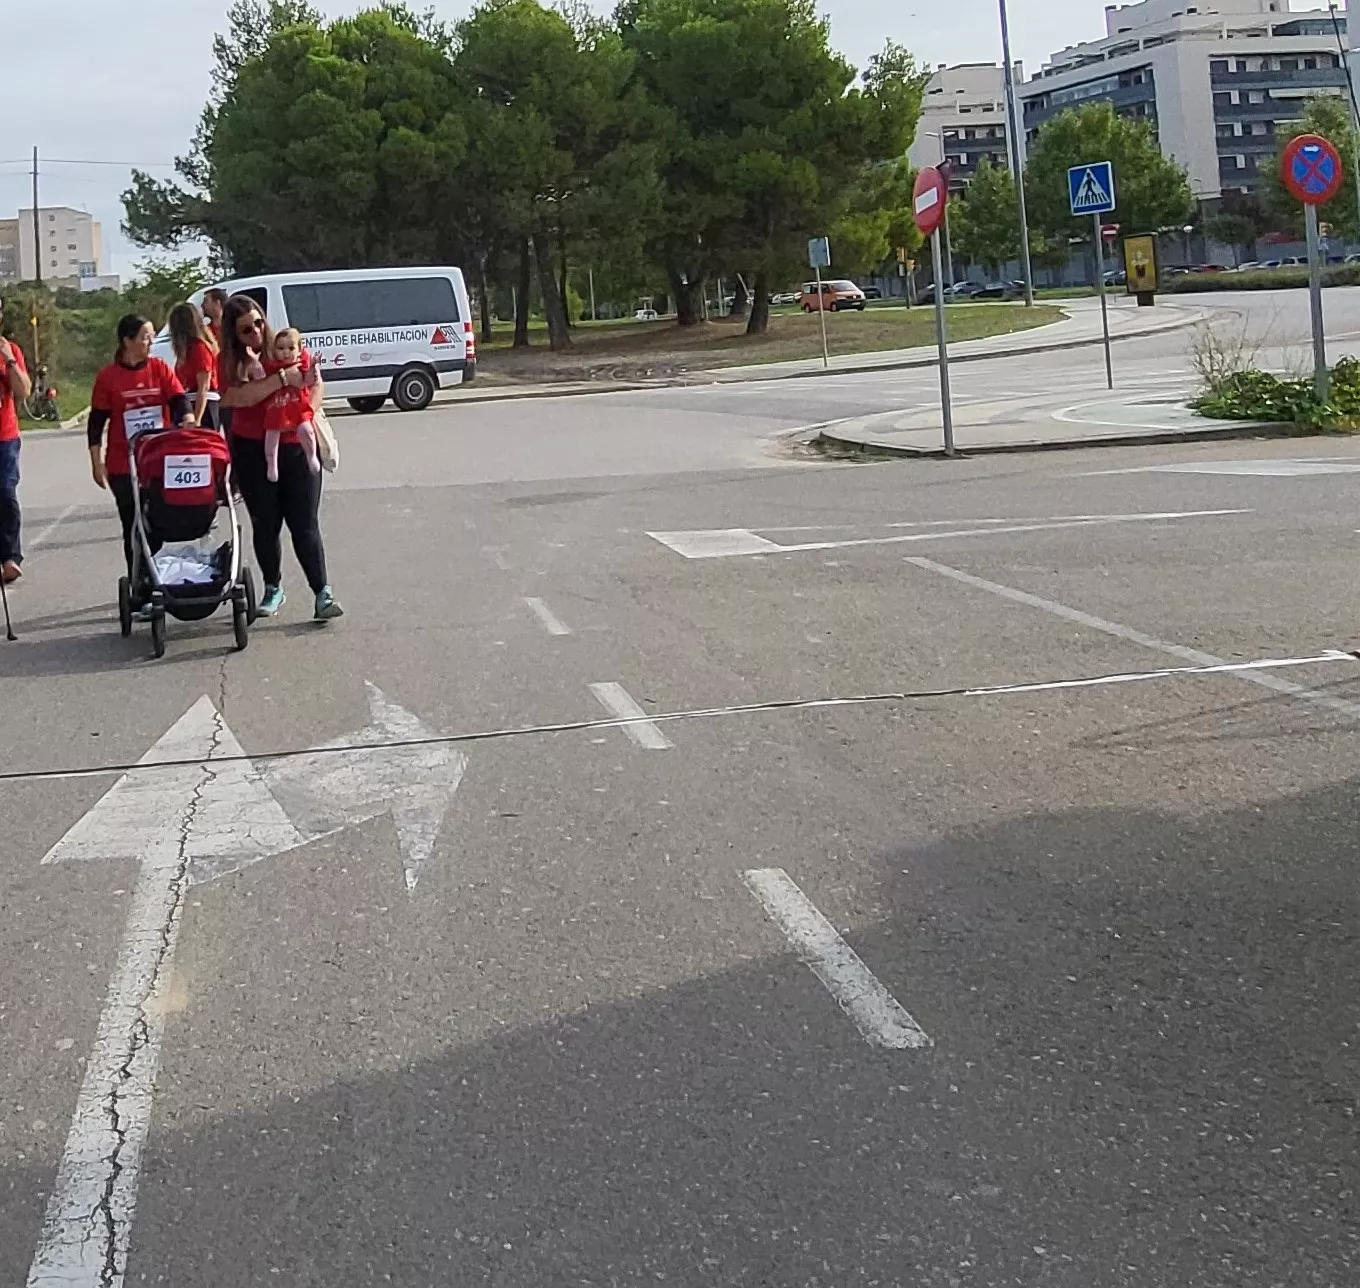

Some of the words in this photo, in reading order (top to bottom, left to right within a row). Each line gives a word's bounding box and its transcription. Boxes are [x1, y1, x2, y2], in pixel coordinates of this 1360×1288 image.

[335, 334, 349, 346] DE
[351, 329, 428, 345] REHABILITACION
[175, 471, 201, 484] 403
